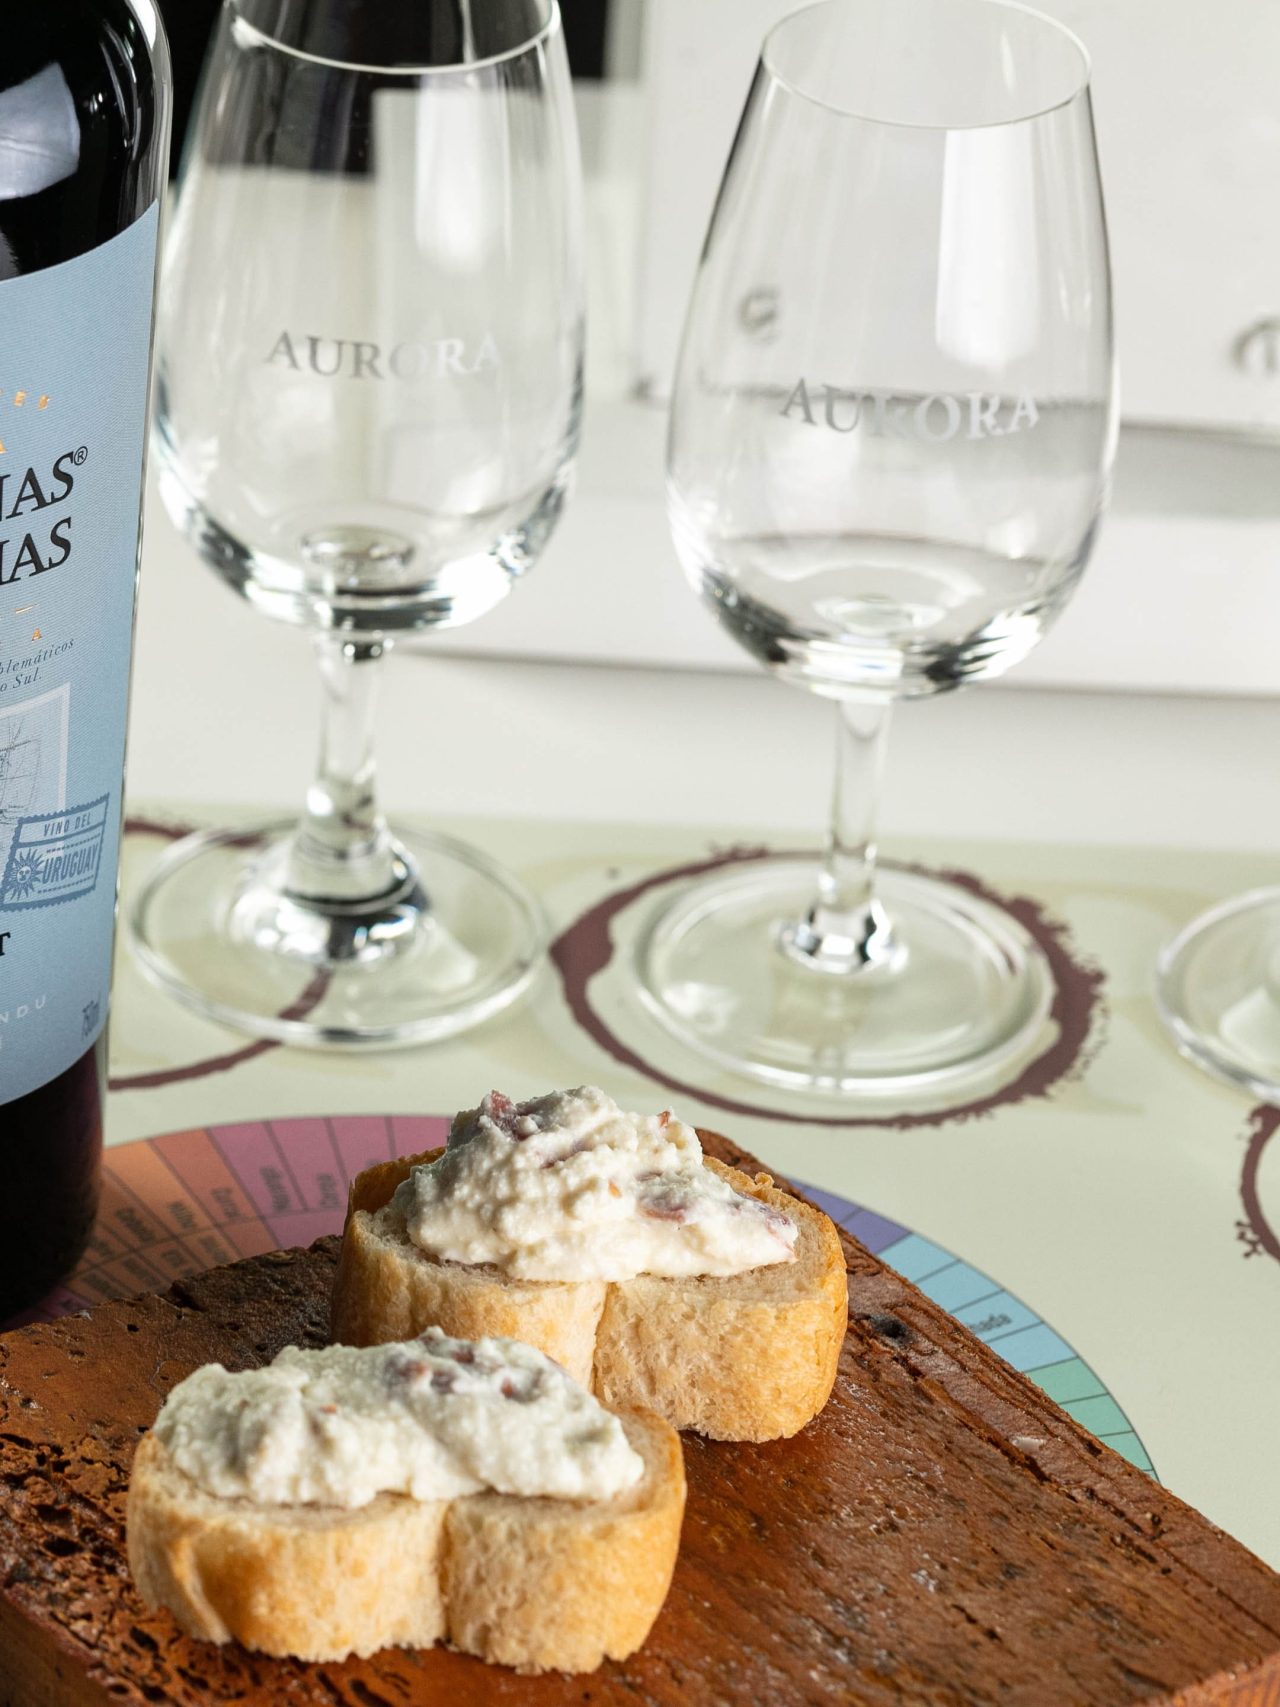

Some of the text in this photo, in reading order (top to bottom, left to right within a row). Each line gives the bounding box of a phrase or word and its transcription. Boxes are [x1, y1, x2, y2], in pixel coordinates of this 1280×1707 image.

[265, 329, 501, 381] AURORA
[43, 812, 91, 837] VINO DEL
[42, 842, 99, 885] URUGUAY
